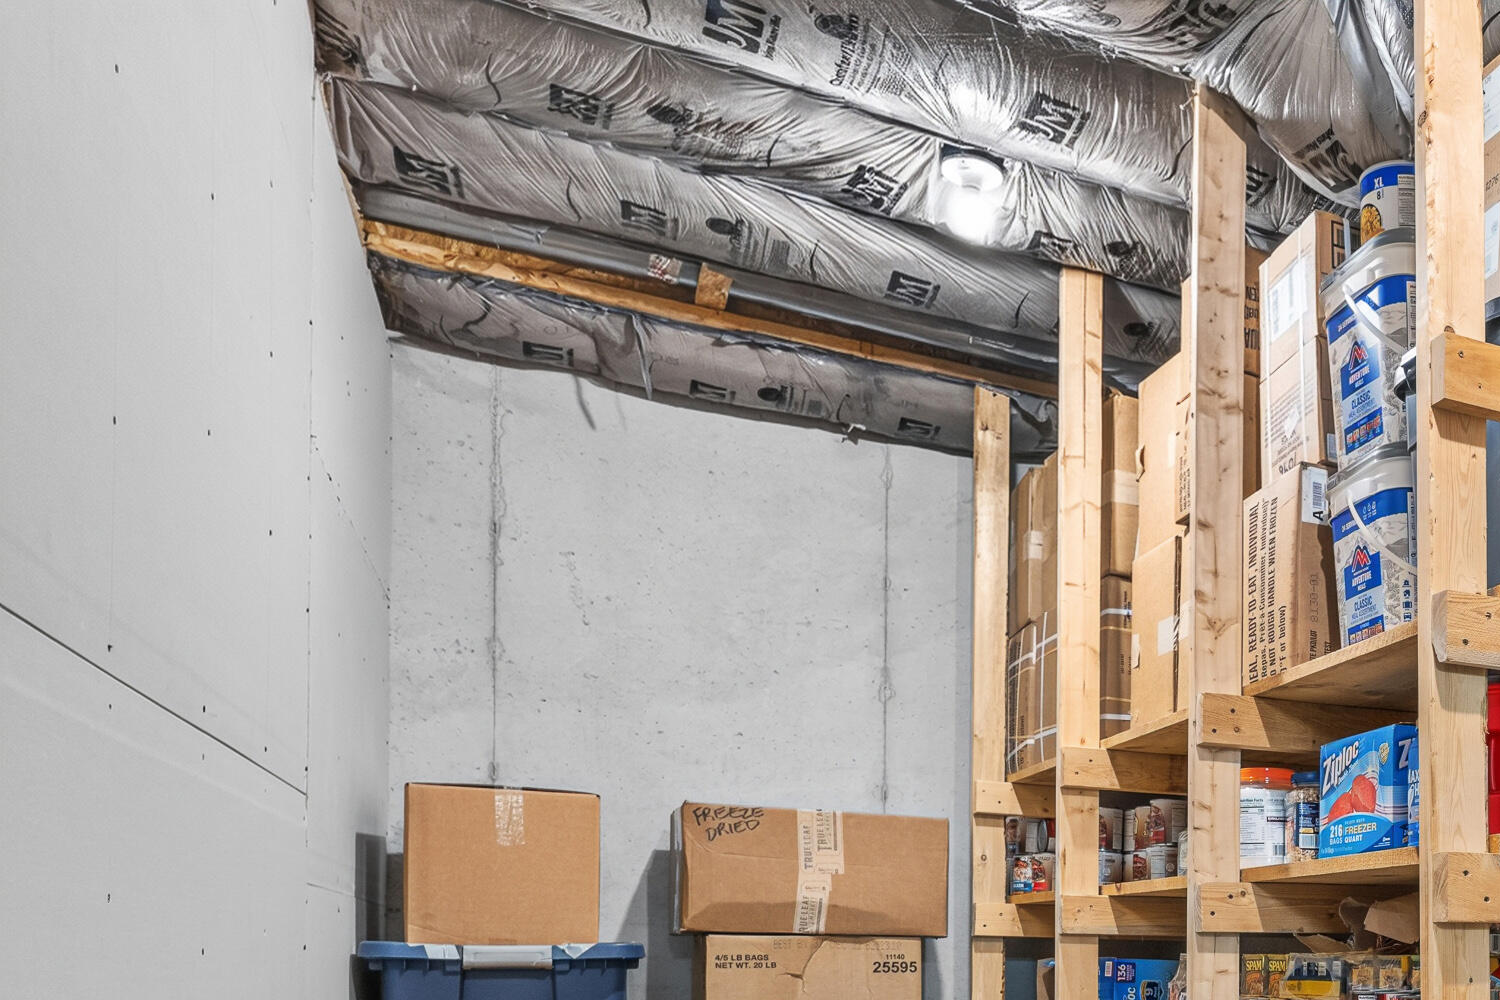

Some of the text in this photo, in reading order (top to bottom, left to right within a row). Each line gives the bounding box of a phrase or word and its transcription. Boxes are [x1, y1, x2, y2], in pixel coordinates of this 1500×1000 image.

[1249, 503, 1259, 568] INDIVIDUAL
[1270, 497, 1278, 646] ROUGH HANDLE WHEN FROZEN
[1323, 741, 1360, 795] Ziploc
[693, 806, 764, 826] FREEZE
[706, 819, 761, 842] DRIED
[1345, 823, 1377, 834] FREEZER
[1330, 834, 1362, 845] BAGS QUART
[765, 961, 777, 969] LB
[872, 961, 918, 973] 25595
[1245, 959, 1262, 971] SPAM
[1268, 959, 1286, 972] SPAM
[1117, 964, 1127, 982] 136
